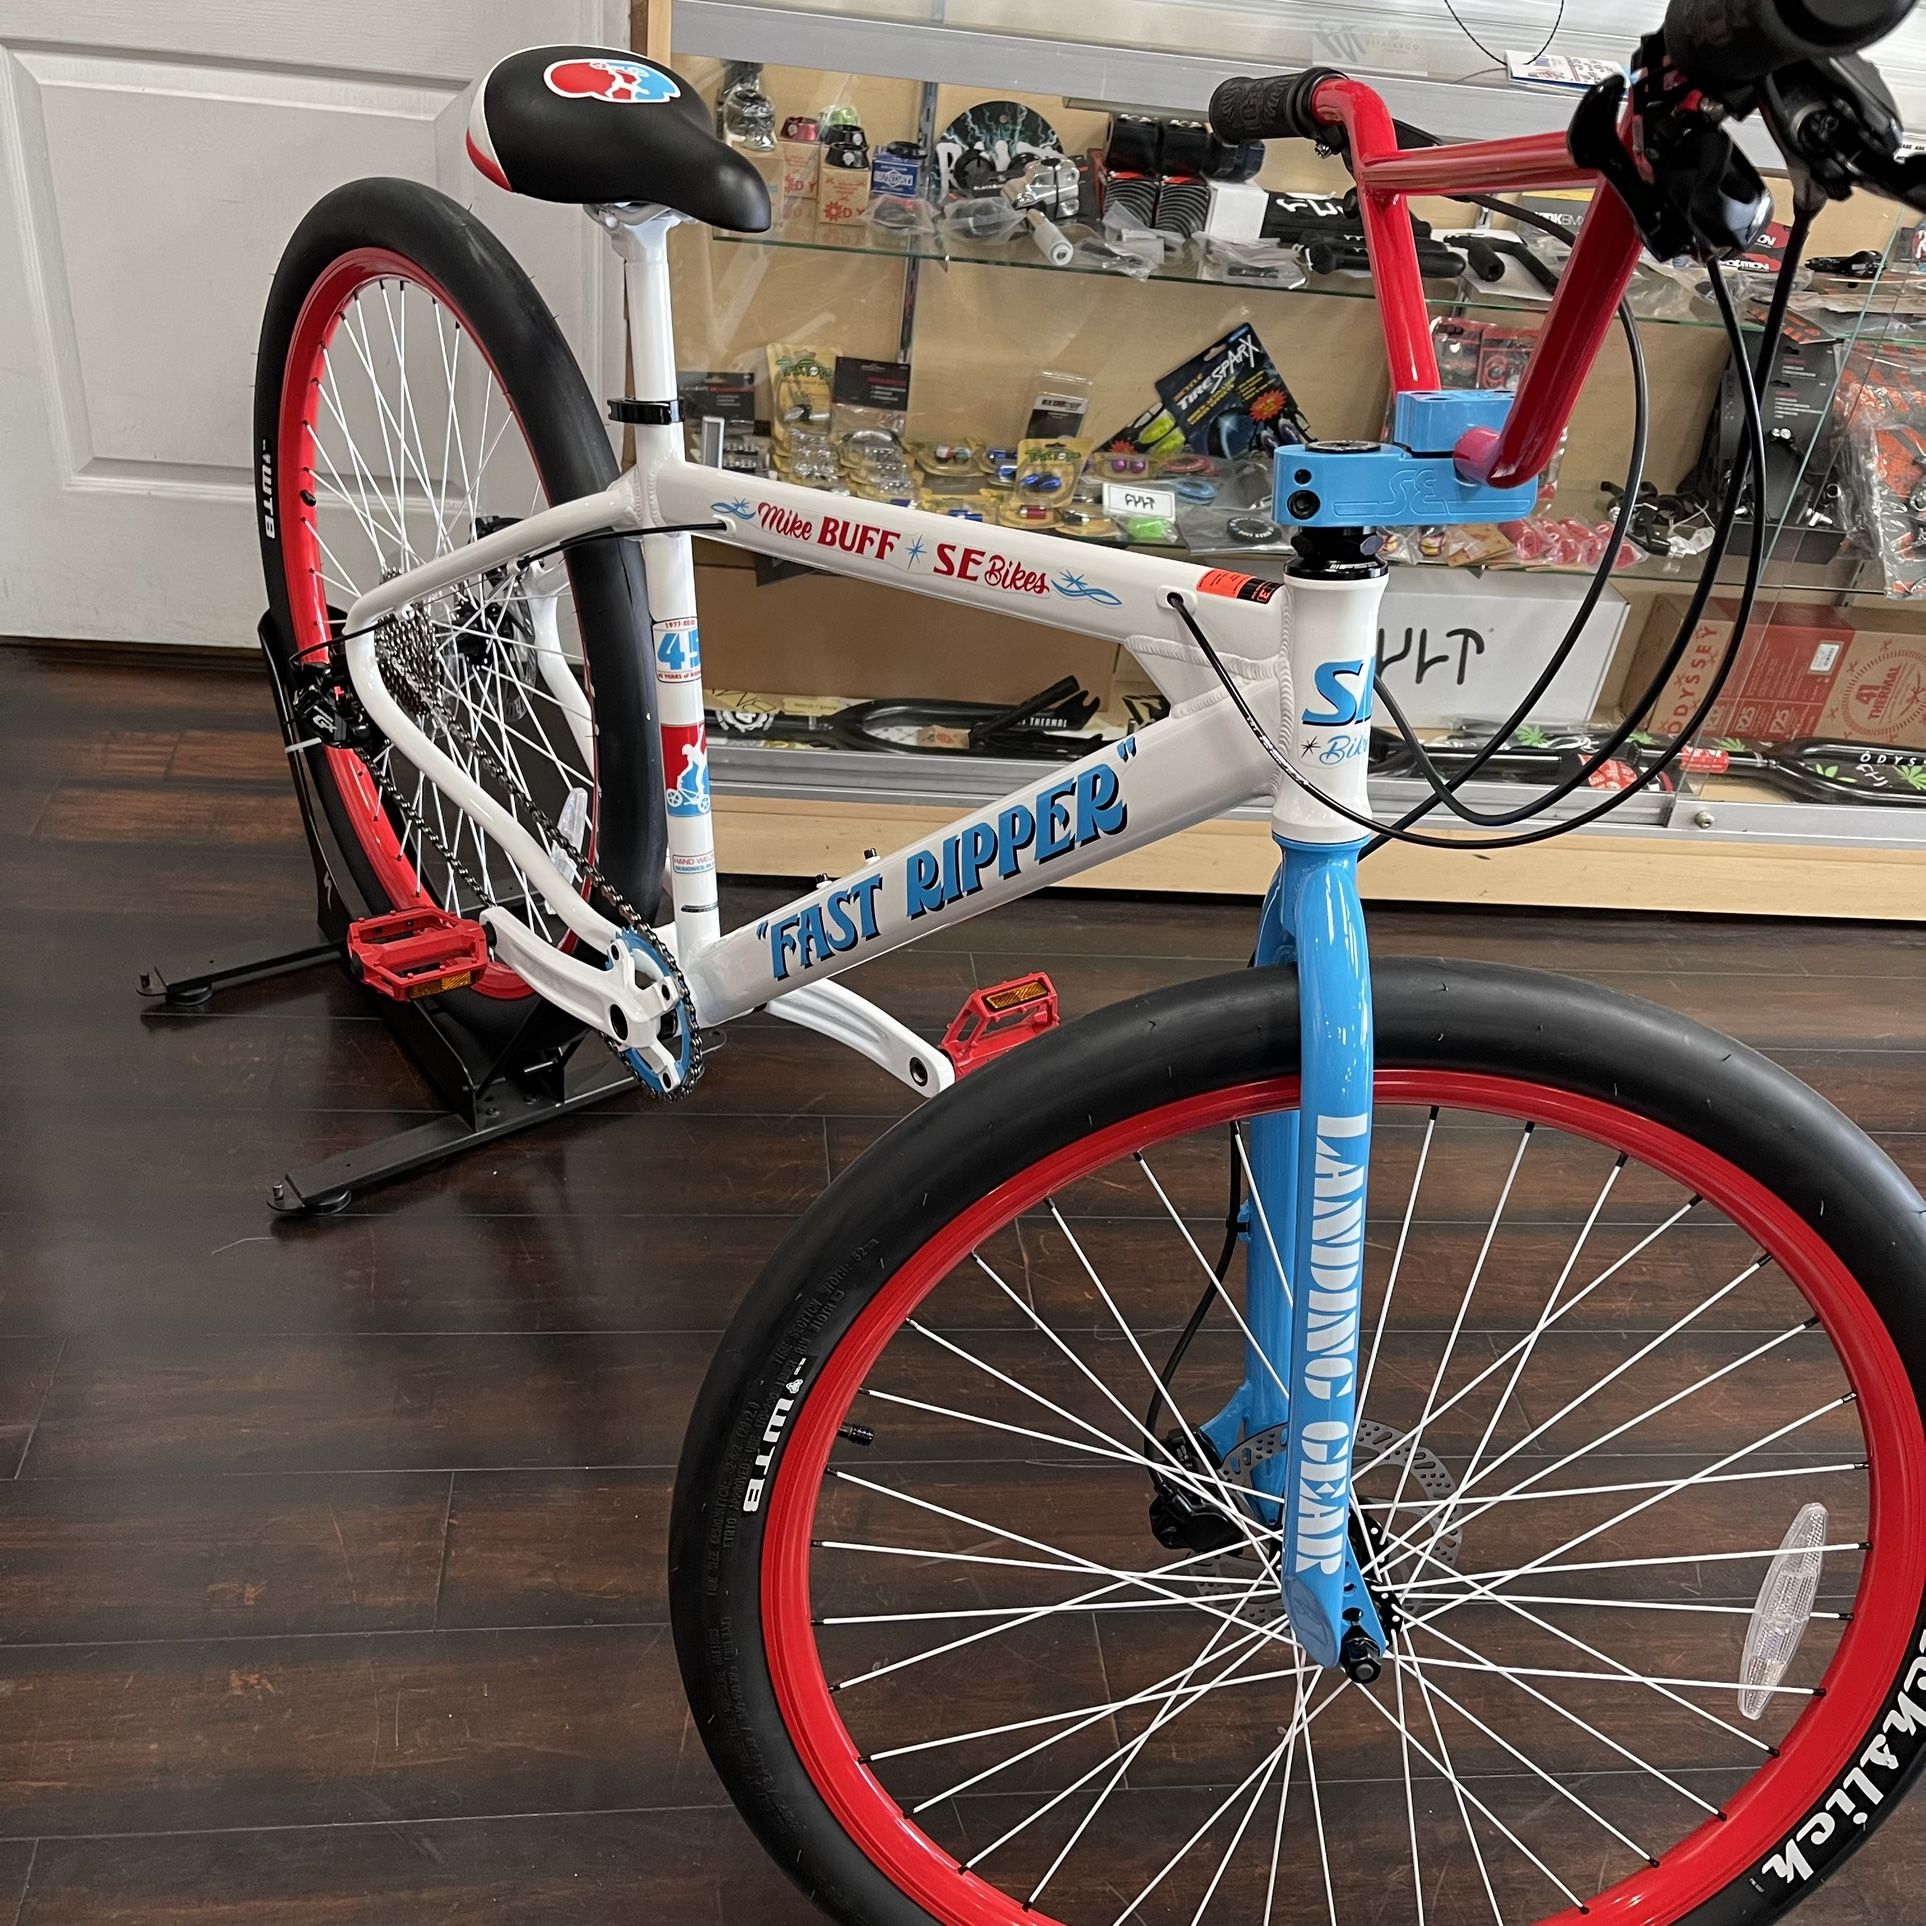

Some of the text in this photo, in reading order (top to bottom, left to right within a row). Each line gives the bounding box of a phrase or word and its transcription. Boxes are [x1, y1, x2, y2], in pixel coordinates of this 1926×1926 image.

[757, 502, 1050, 595] Mike BUFF SE Bikes
[1375, 627, 1485, 685] ULT
[1029, 717, 1068, 728] THERMAL
[1319, 735, 1368, 765] Bik
[1860, 751, 1926, 767] ODYS
[1295, 1114, 1367, 1576] LANDING GEAR
[1762, 1629, 1926, 1885] ckslick
